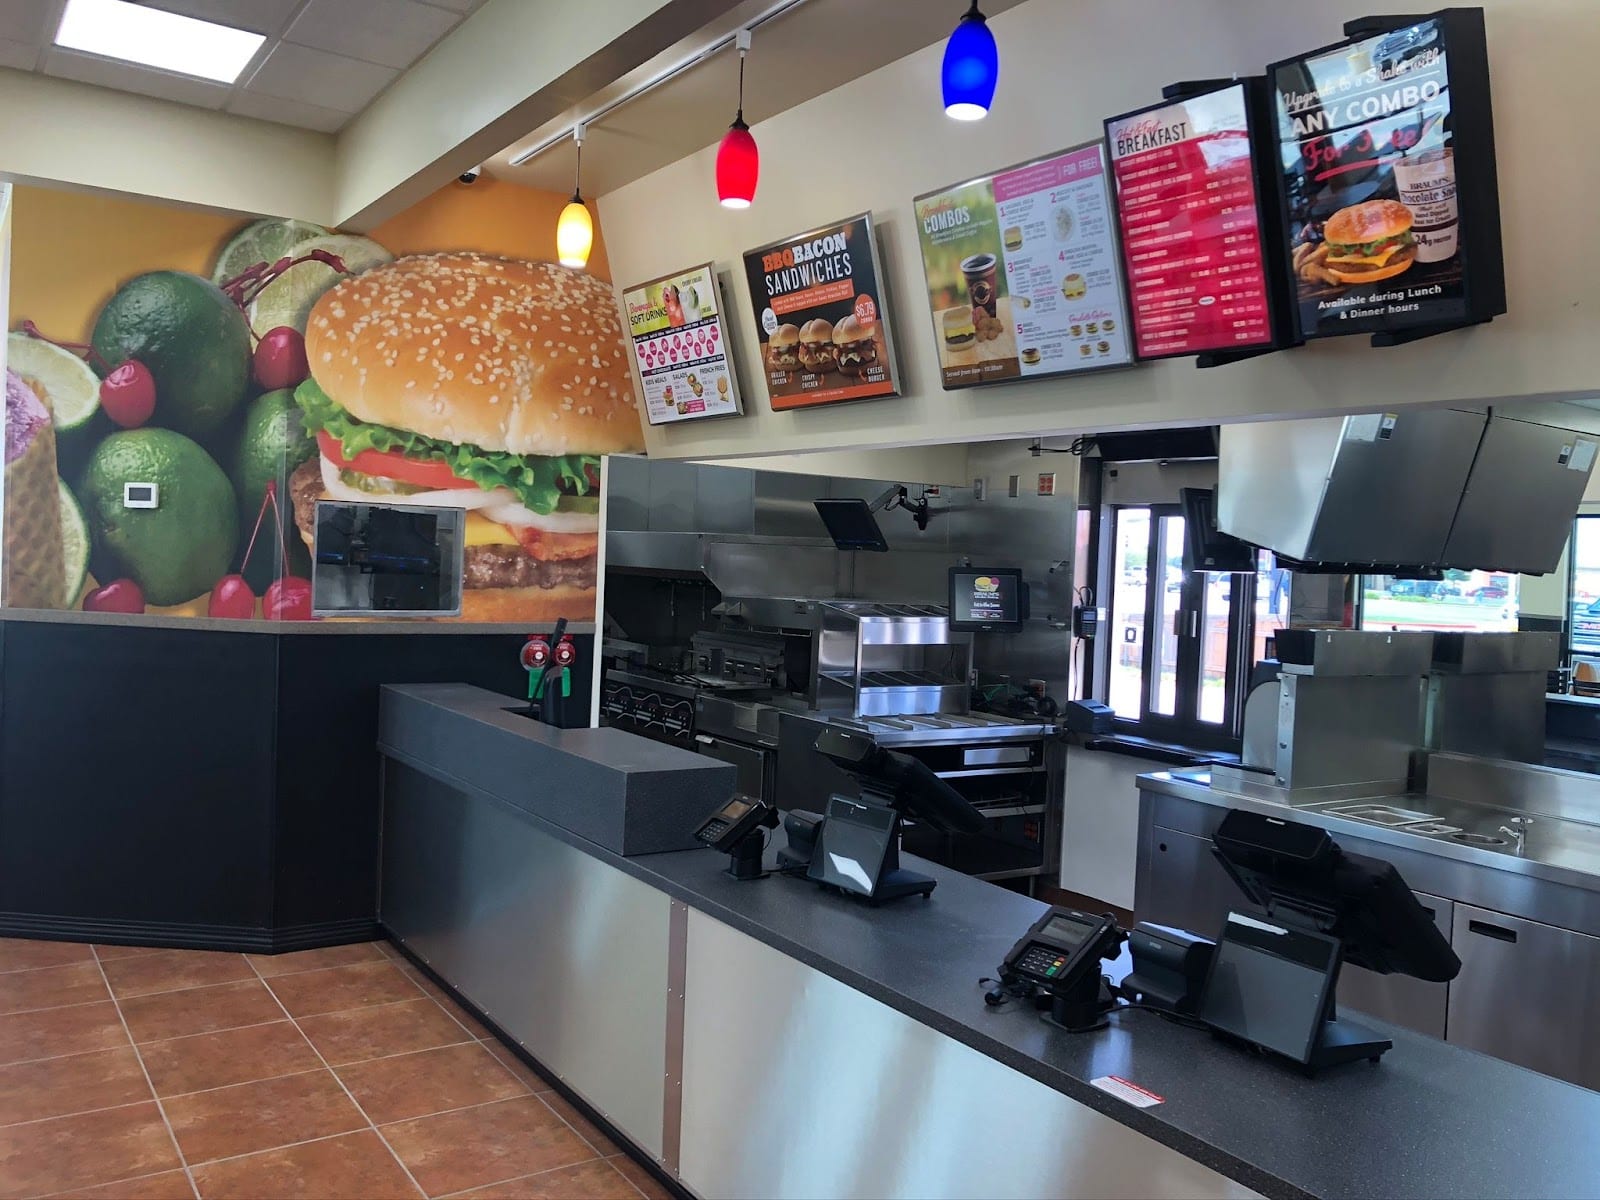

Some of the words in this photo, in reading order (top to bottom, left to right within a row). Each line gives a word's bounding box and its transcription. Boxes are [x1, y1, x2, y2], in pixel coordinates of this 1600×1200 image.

[1366, 59, 1406, 84] Shake
[1292, 107, 1338, 137] ANY
[1346, 80, 1440, 122] COMBO
[1118, 122, 1186, 156] BREAKFAST
[1303, 135, 1349, 171] For
[1050, 192, 1057, 204] 2
[923, 206, 970, 235] COMBOS
[1000, 207, 1006, 218] 1
[1059, 250, 1065, 262] 4
[765, 252, 852, 296] SANDWICHES
[1008, 262, 1014, 273] 3
[1318, 294, 1366, 310] Available
[1369, 290, 1405, 304] during
[1408, 284, 1442, 298] Lunch
[630, 313, 645, 326] SOFT
[646, 306, 668, 321] DRINKS
[855, 302, 875, 318] $6.79
[1340, 310, 1348, 320] &
[1350, 306, 1385, 319] Dinner
[1388, 302, 1419, 314] hours
[1017, 324, 1024, 335] 5
